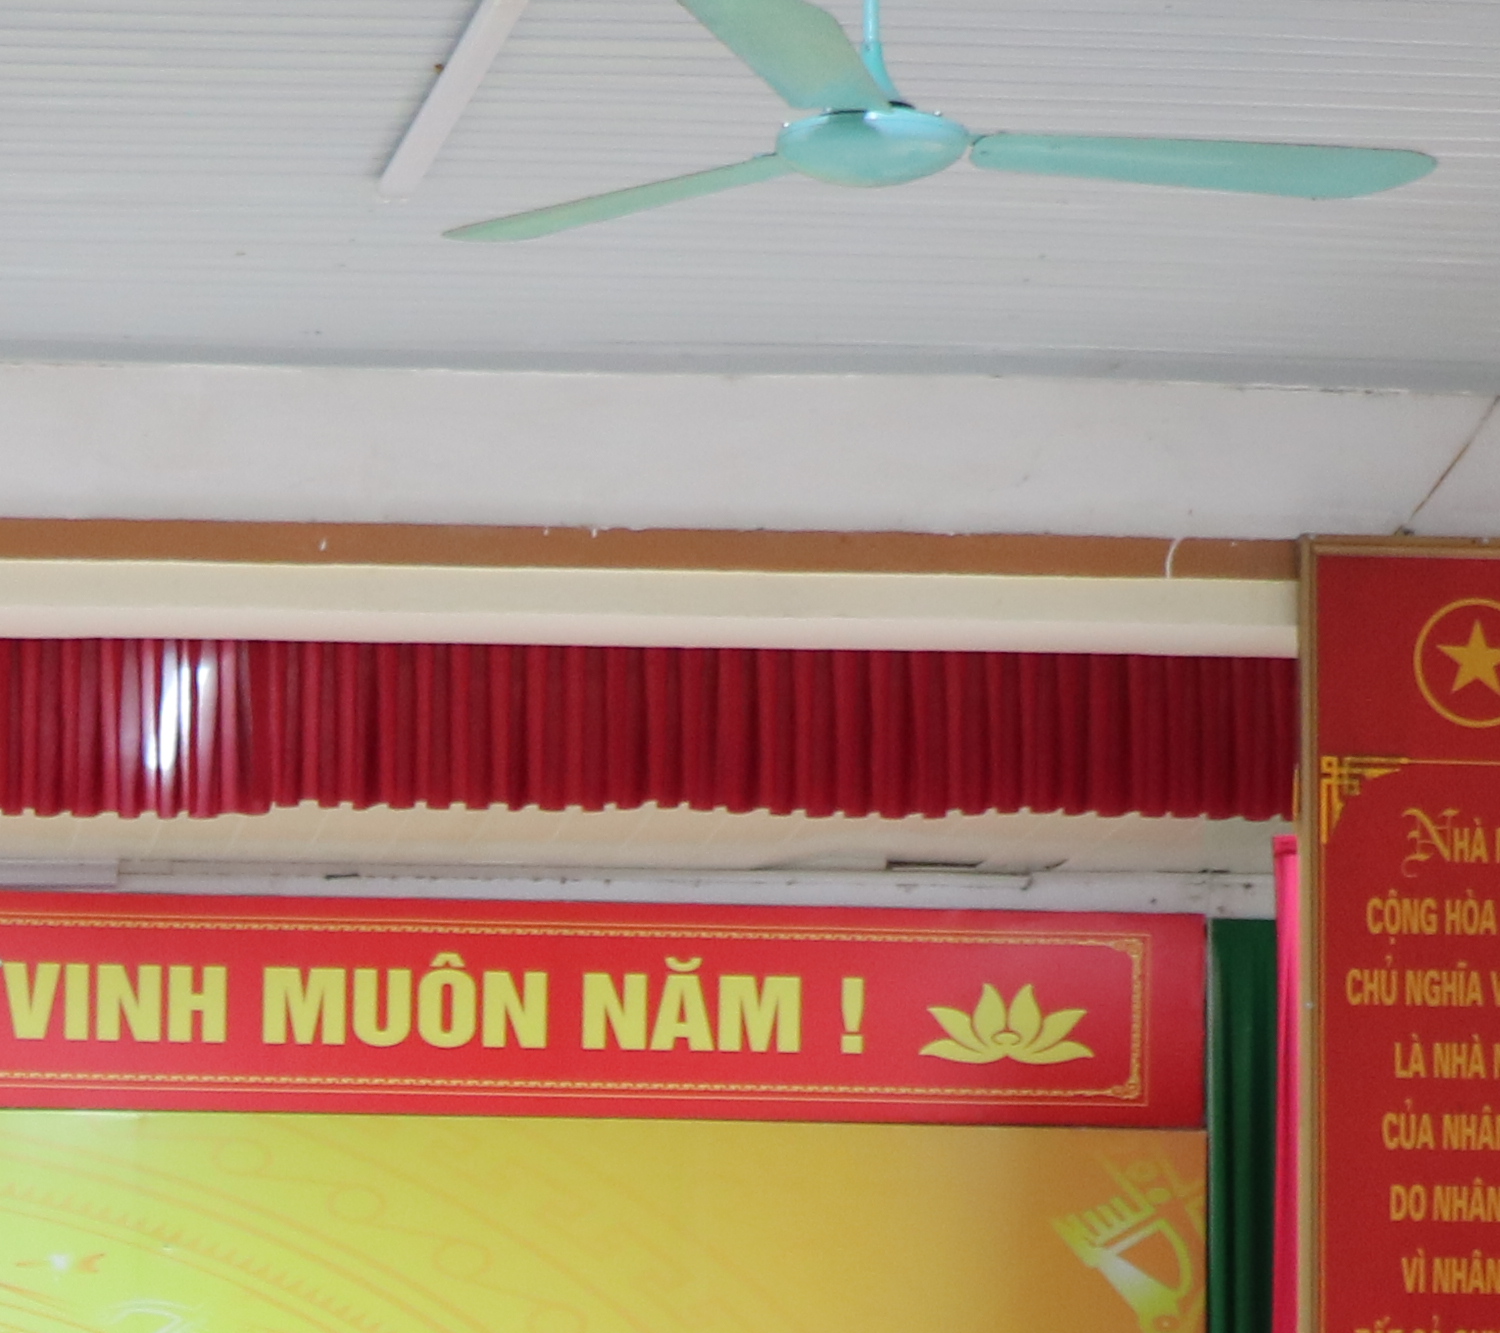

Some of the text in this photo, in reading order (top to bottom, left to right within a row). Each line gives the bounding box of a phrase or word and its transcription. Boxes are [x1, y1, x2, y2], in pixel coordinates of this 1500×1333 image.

[1401, 807, 1489, 877] NHÀ
[1366, 888, 1437, 945] CỘNG
[1444, 888, 1497, 936] HÒA
[6, 961, 228, 1046] VINH
[262, 954, 550, 1053] MUÔN
[580, 954, 803, 1055] NĂM
[1346, 954, 1398, 1006] CHỦ
[1405, 960, 1484, 1007] NGHĨA
[1394, 1032, 1426, 1079] LÀ
[1433, 1033, 1486, 1080] NHÀ
[1382, 1098, 1435, 1150] CỦA
[1390, 1184, 1427, 1222] DO
[1401, 1248, 1426, 1293] VÌ
